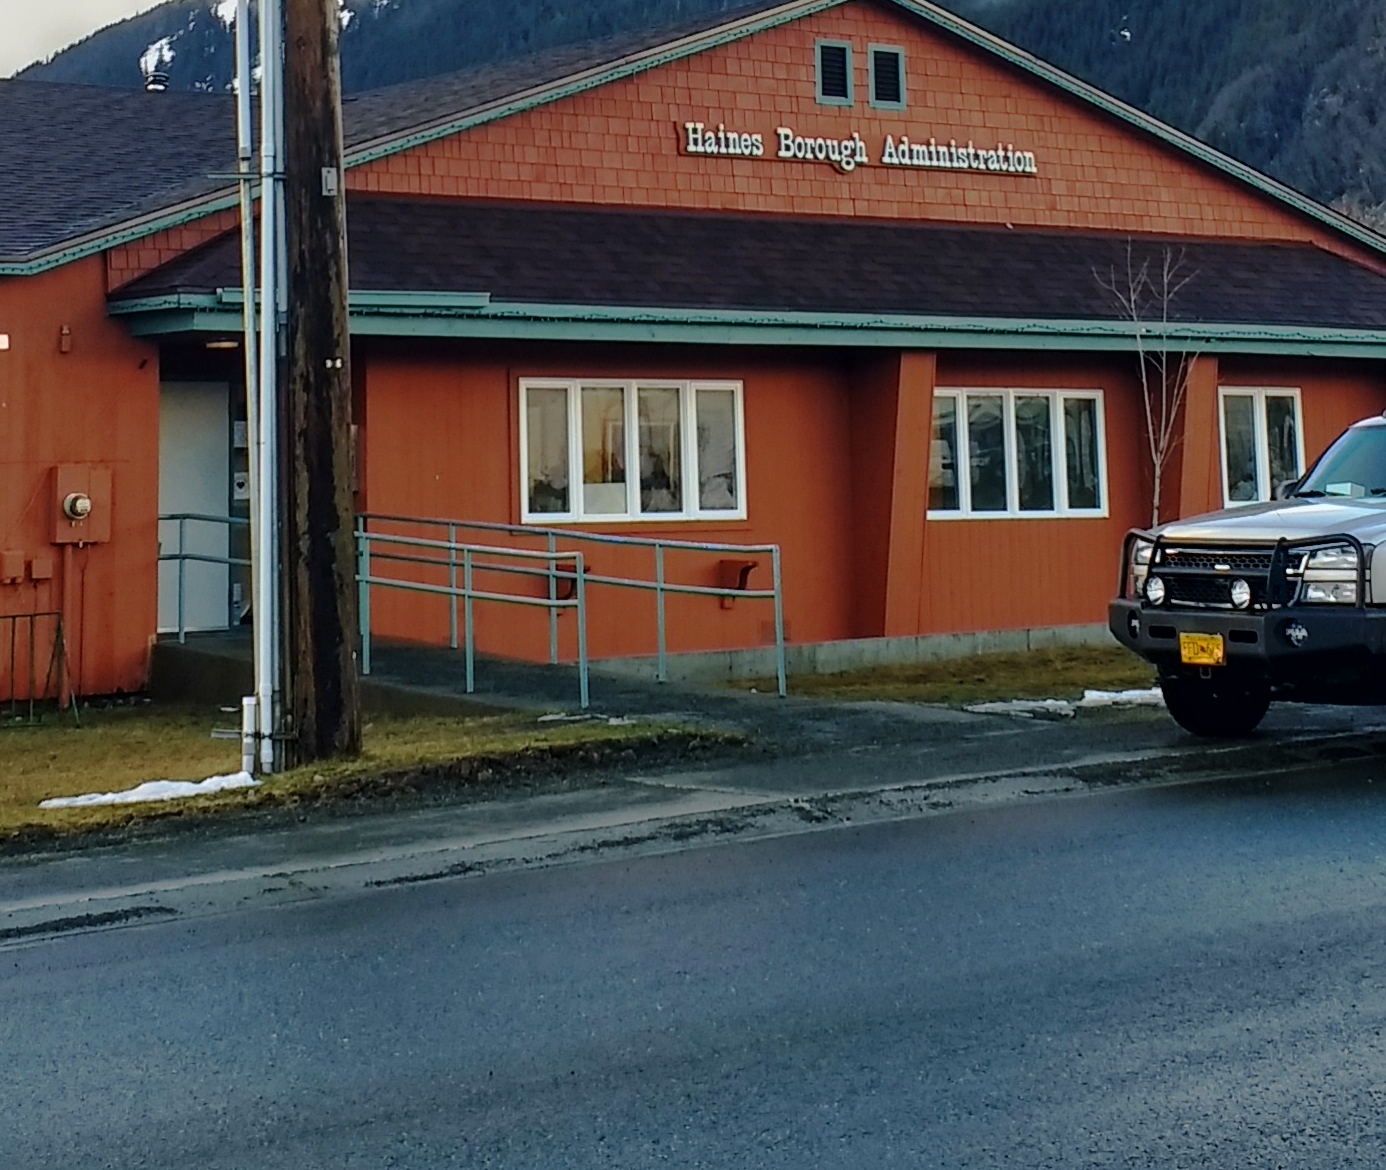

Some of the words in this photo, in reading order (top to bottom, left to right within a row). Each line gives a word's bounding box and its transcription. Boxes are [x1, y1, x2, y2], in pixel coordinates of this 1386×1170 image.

[685, 122, 763, 156] Haines
[776, 127, 868, 171] Borough
[882, 134, 1037, 173] Administration
